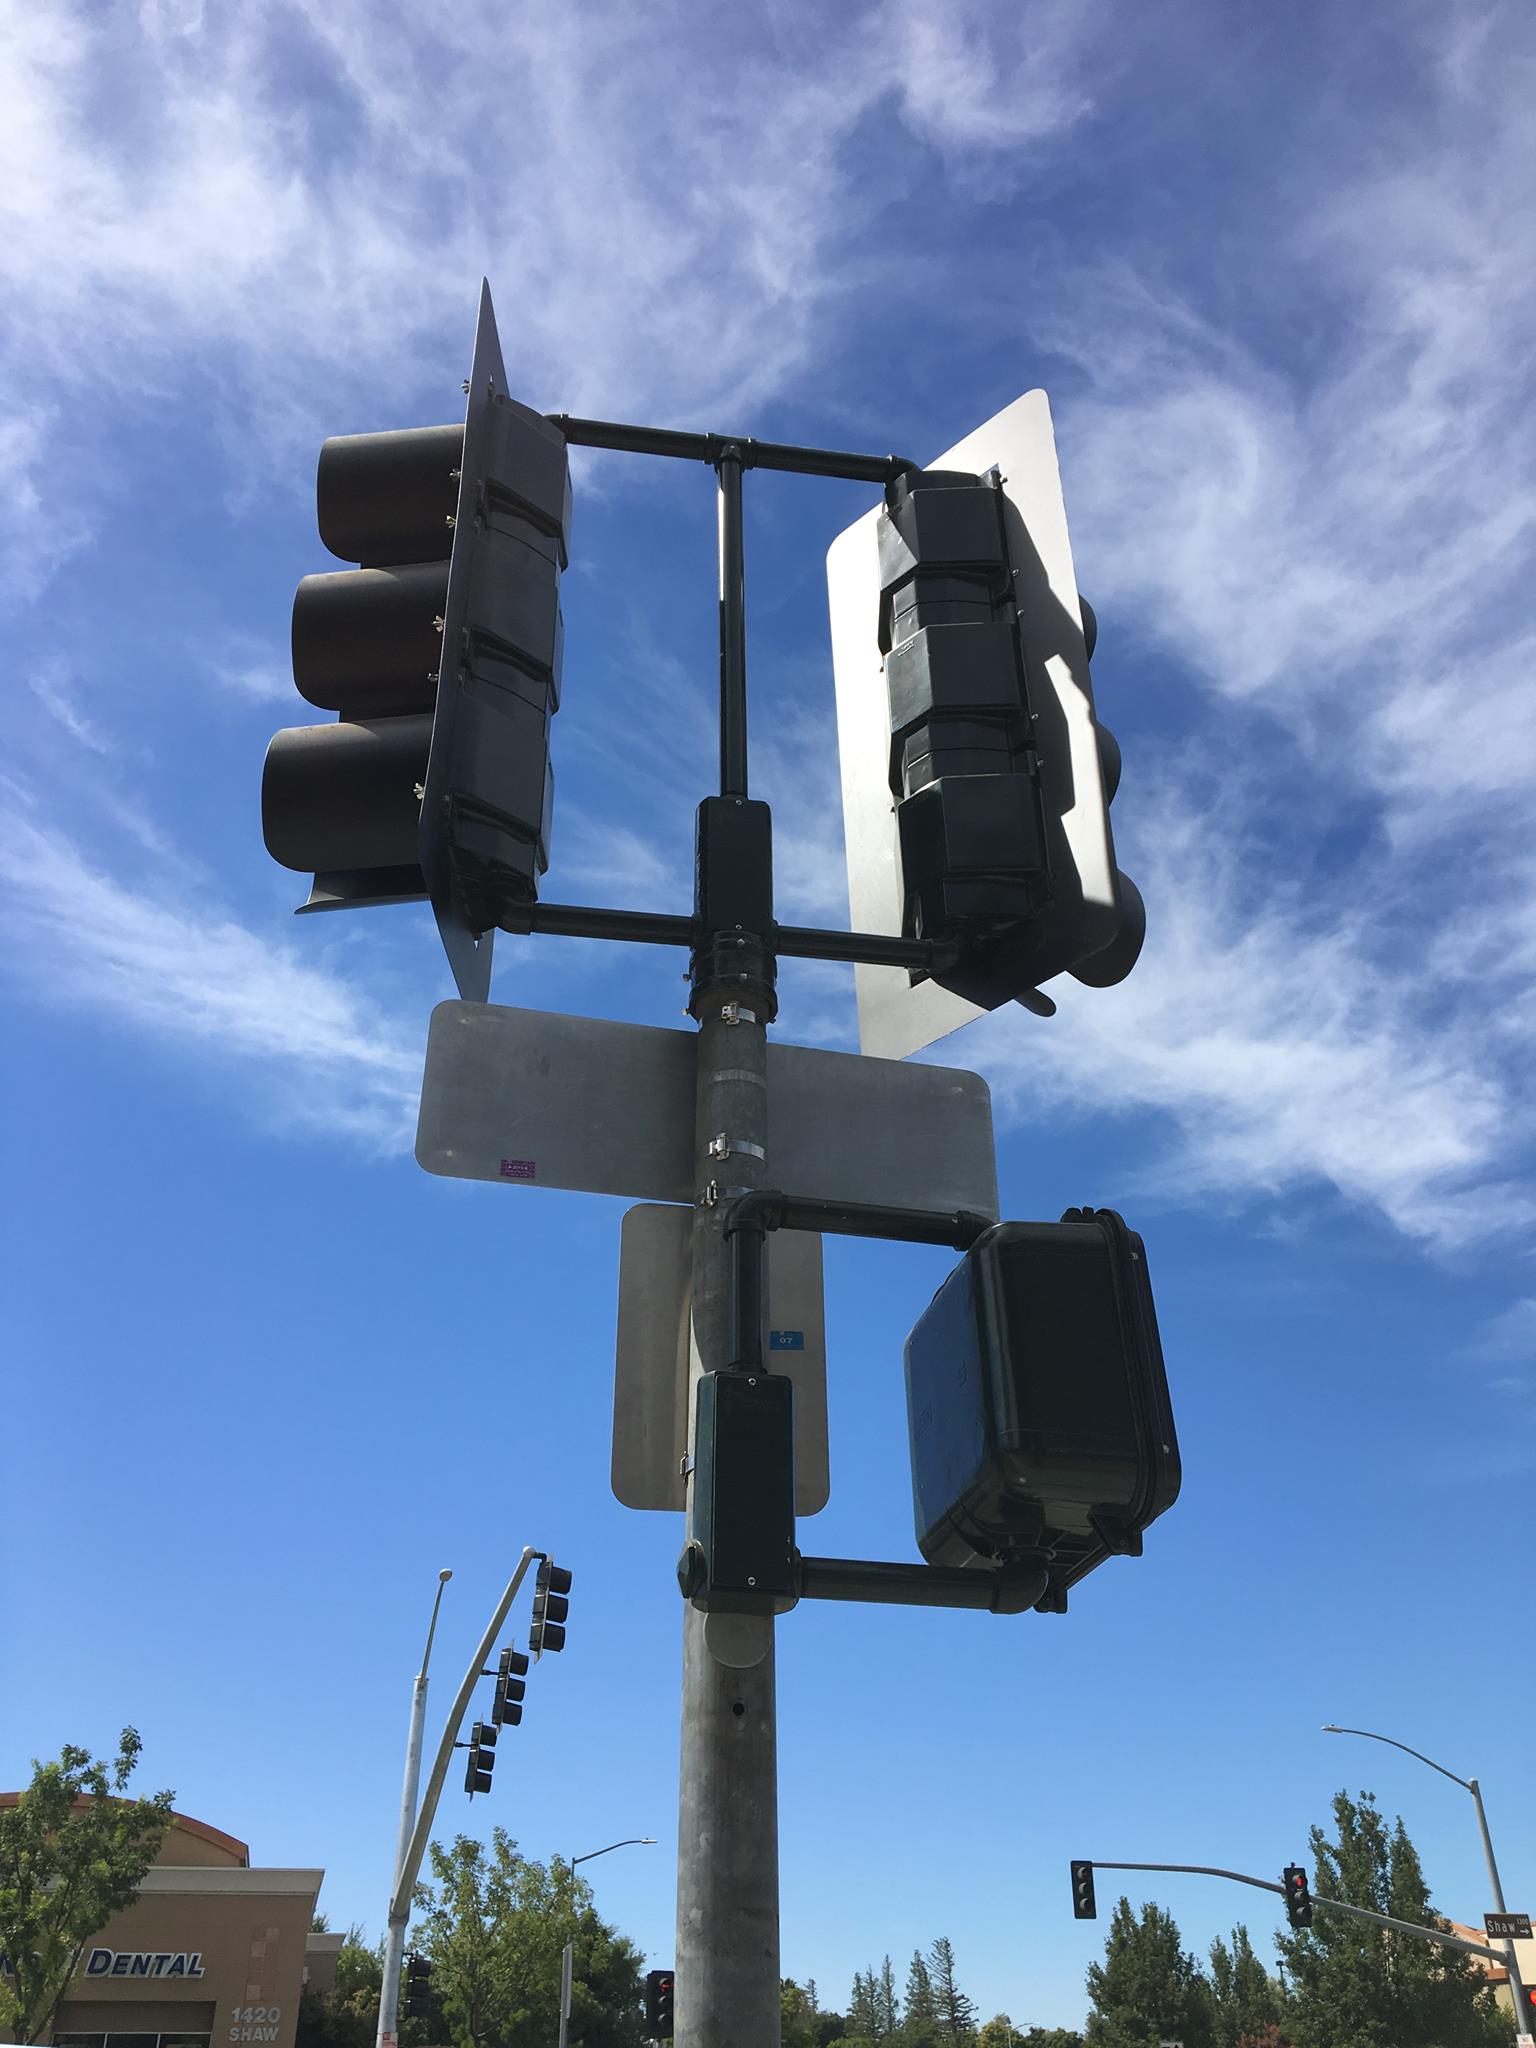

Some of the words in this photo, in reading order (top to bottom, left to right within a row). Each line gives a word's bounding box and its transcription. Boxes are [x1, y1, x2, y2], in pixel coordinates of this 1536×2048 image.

[1487, 1920, 1515, 1933] Shaw
[85, 1948, 204, 1977] DENTAL
[231, 2007, 281, 2024] 1420
[229, 2027, 279, 2041] SHAW
